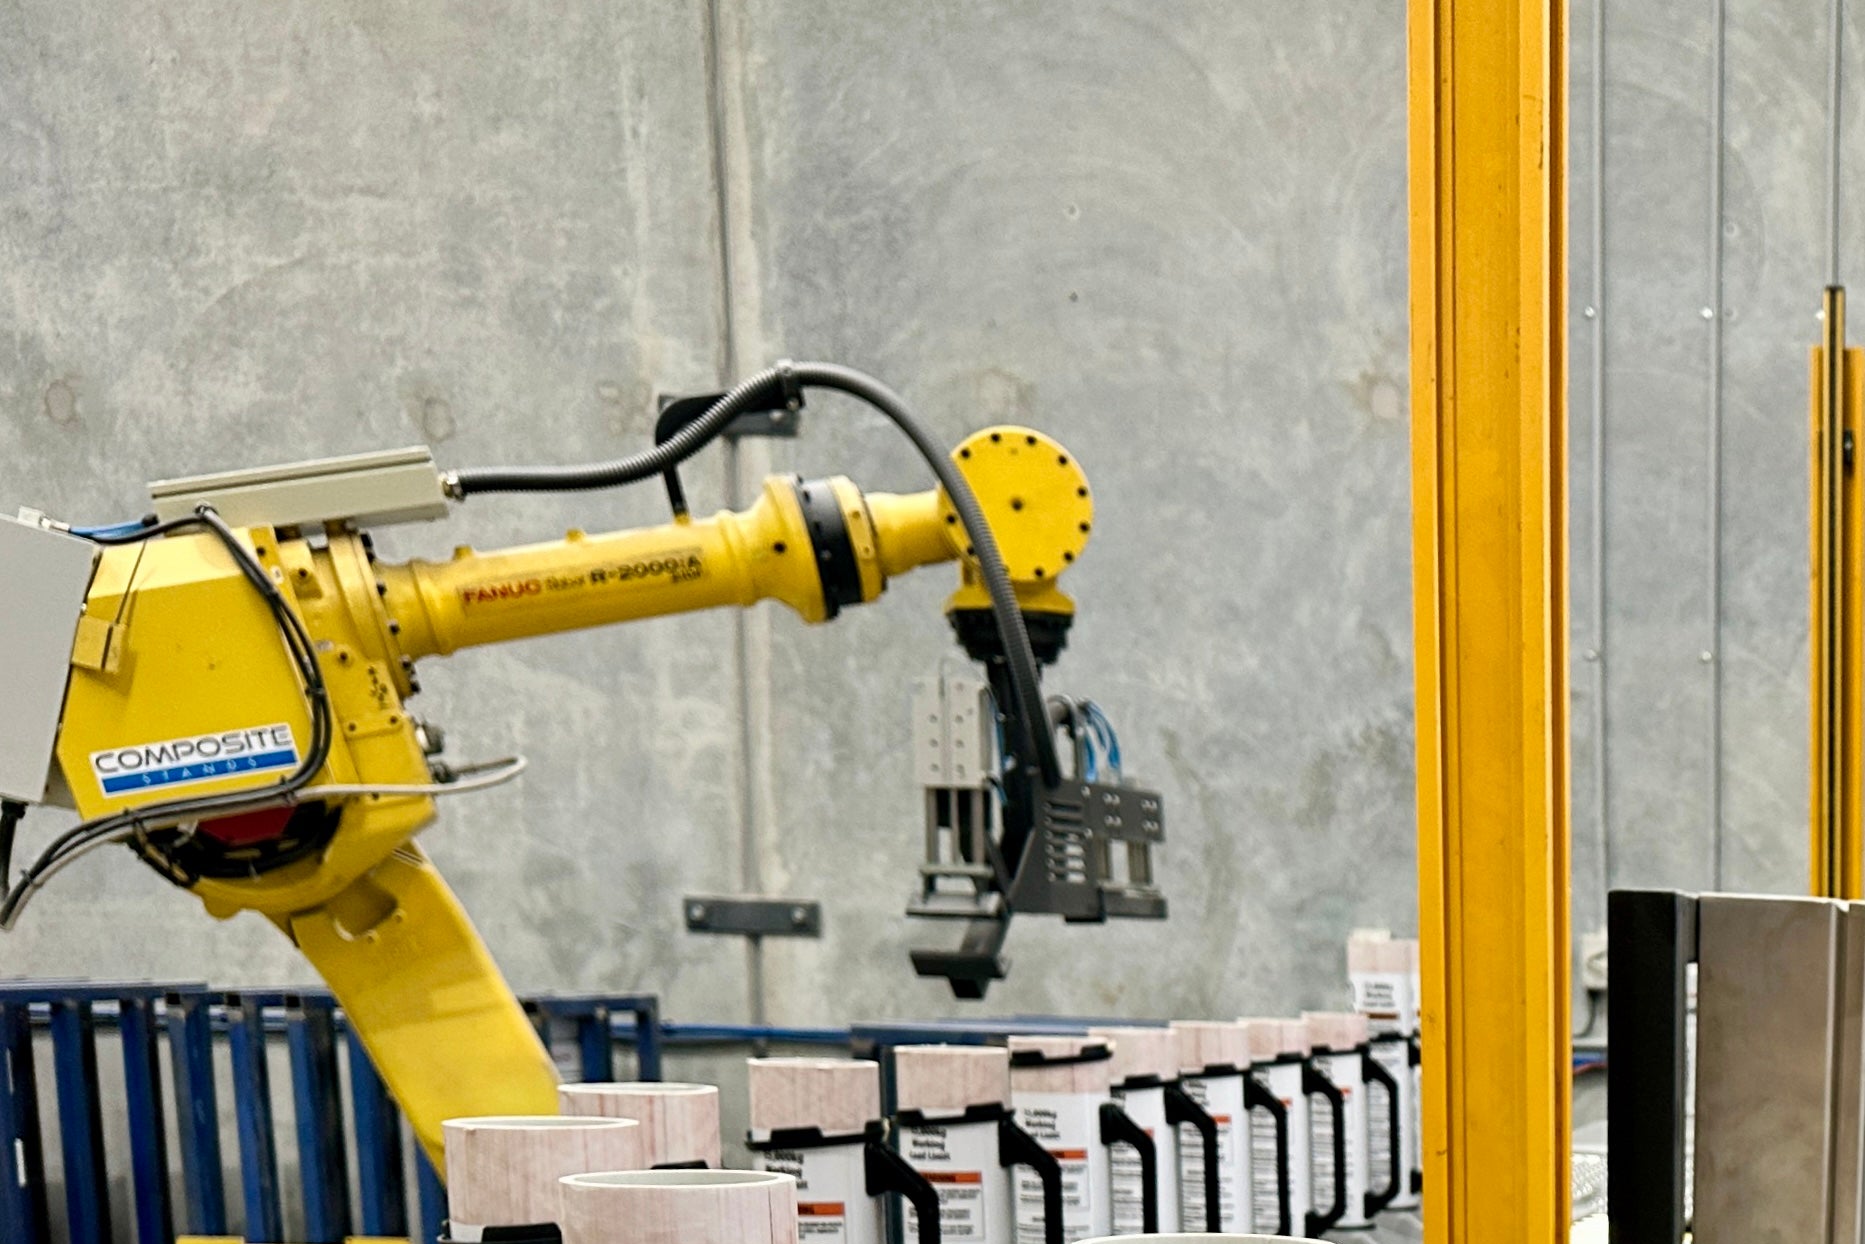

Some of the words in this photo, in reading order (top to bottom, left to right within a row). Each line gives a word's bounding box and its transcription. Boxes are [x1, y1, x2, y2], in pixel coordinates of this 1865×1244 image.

[463, 579, 542, 603] FANUC
[95, 725, 293, 774] COMPOSITE
[141, 758, 258, 785] STANDS
